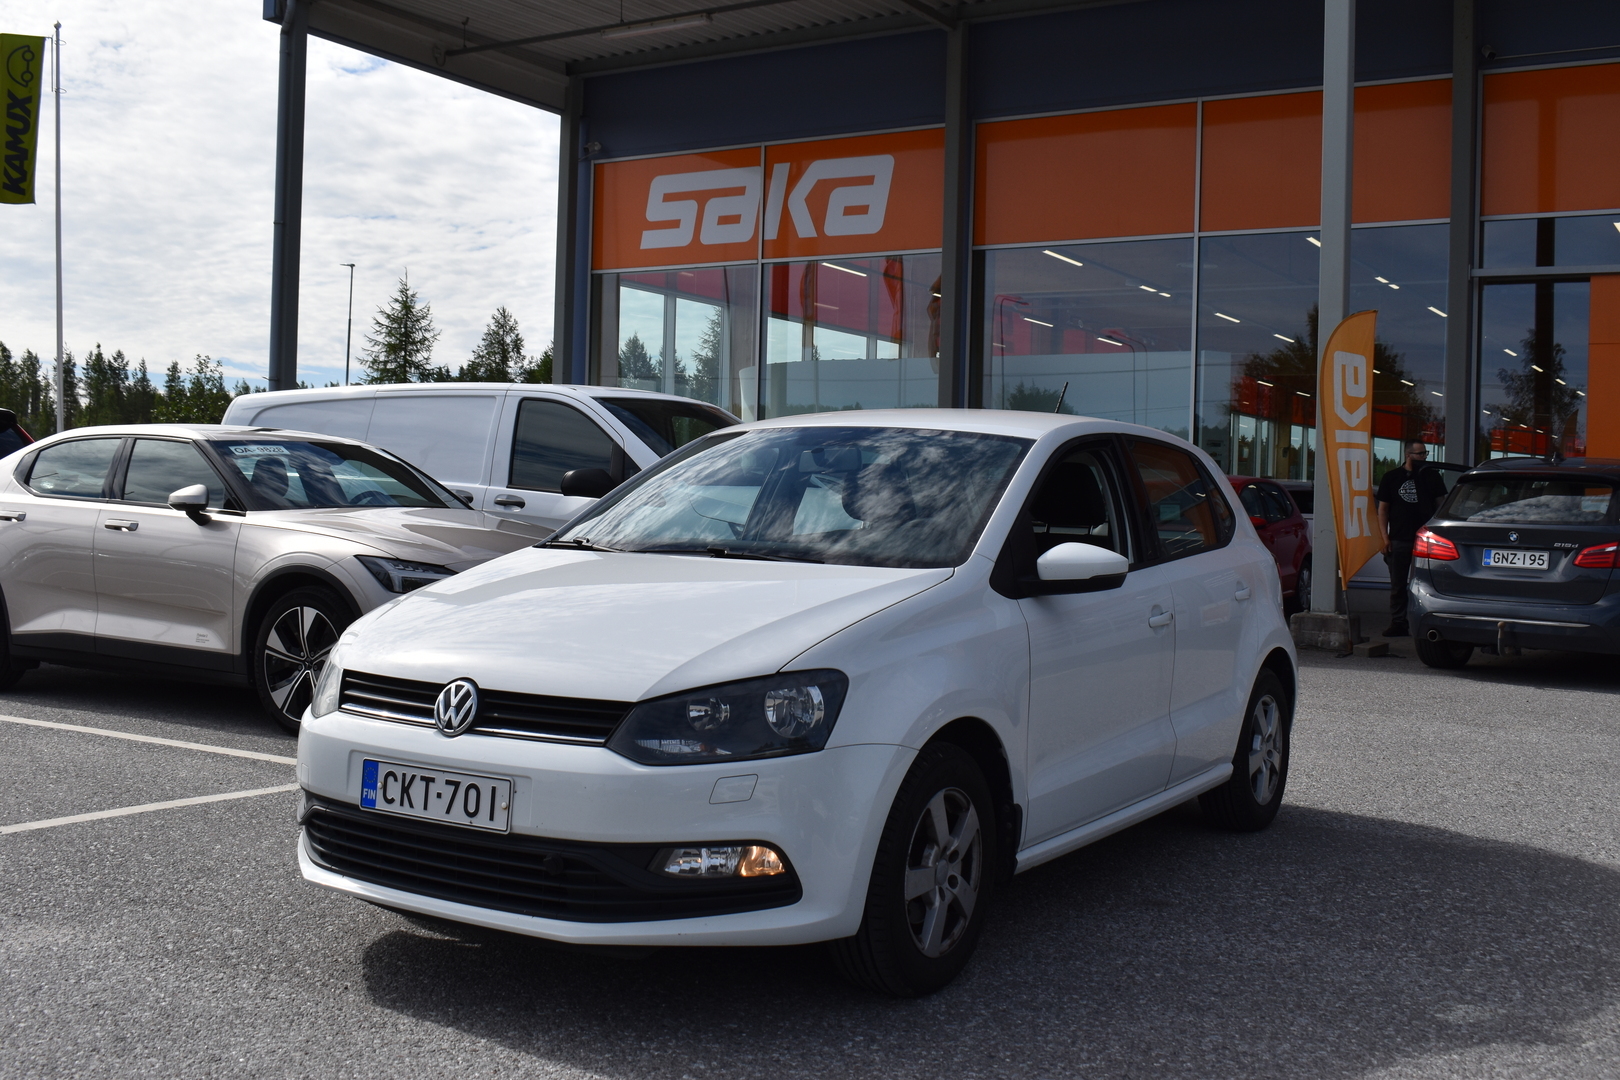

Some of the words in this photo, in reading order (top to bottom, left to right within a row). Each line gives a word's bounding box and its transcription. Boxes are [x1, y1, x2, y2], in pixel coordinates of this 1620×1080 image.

[2, 89, 32, 196] KAMUX
[1493, 552, 1545, 566] GNZ-195
[363, 788, 376, 800] FIN
[382, 770, 497, 822] CKT-701
